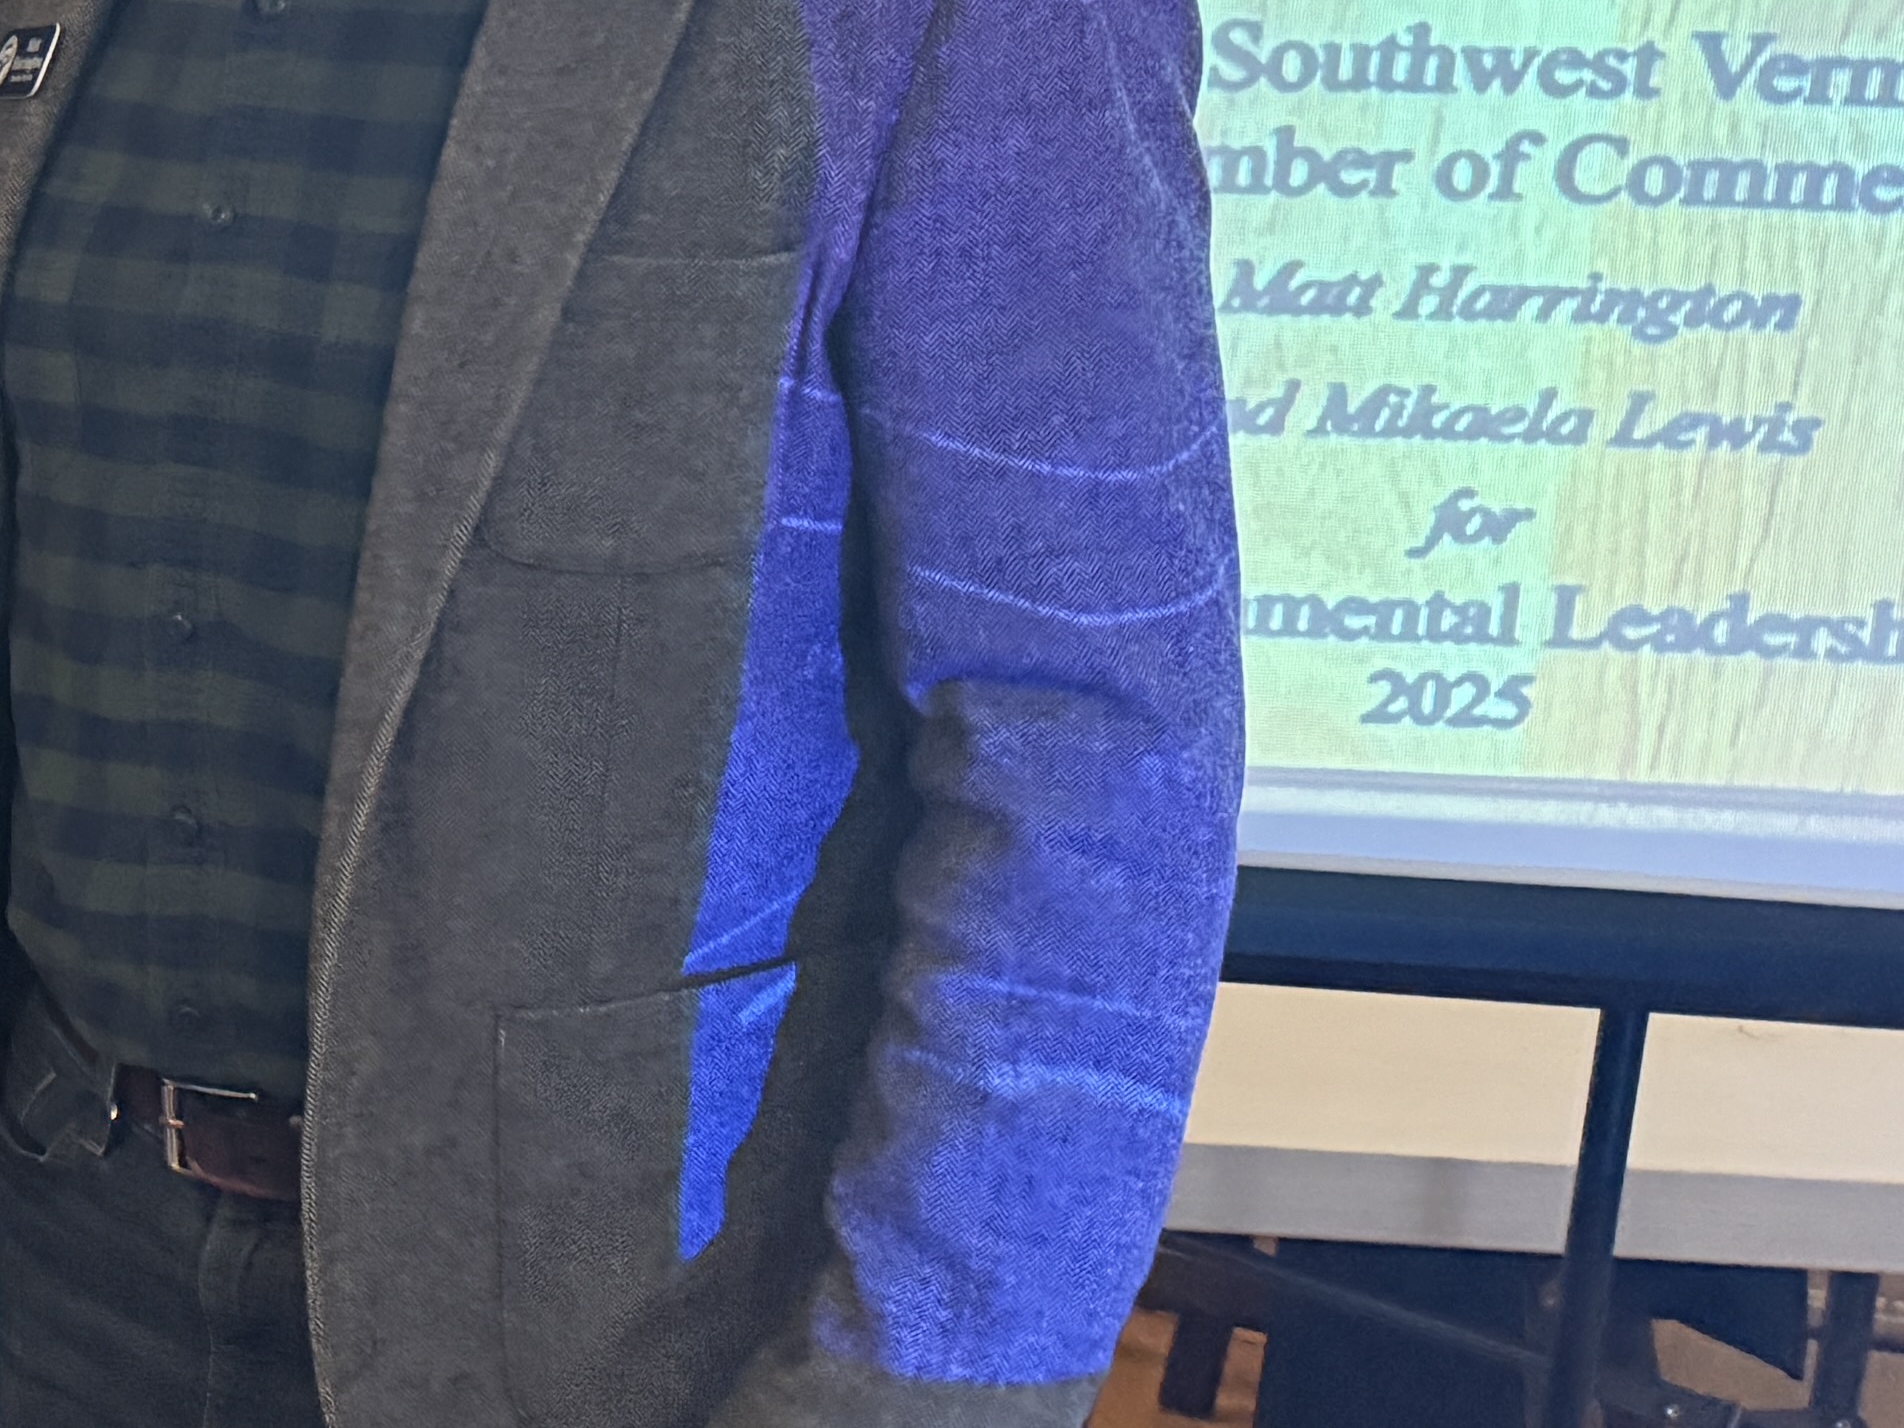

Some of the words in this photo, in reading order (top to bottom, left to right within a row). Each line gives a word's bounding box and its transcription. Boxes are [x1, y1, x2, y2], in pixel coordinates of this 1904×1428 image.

[1207, 17, 1666, 101] Southwest
[1436, 130, 1547, 203] of
[1555, 134, 1904, 215] Comme
[1218, 259, 1384, 317] Matt
[1394, 263, 1803, 343] Harrington
[1306, 383, 1594, 447] Mikaela
[1606, 390, 1825, 456] Lewis
[1405, 488, 1536, 558] for
[1242, 580, 1521, 646] mental
[1360, 669, 1536, 730] 2025
